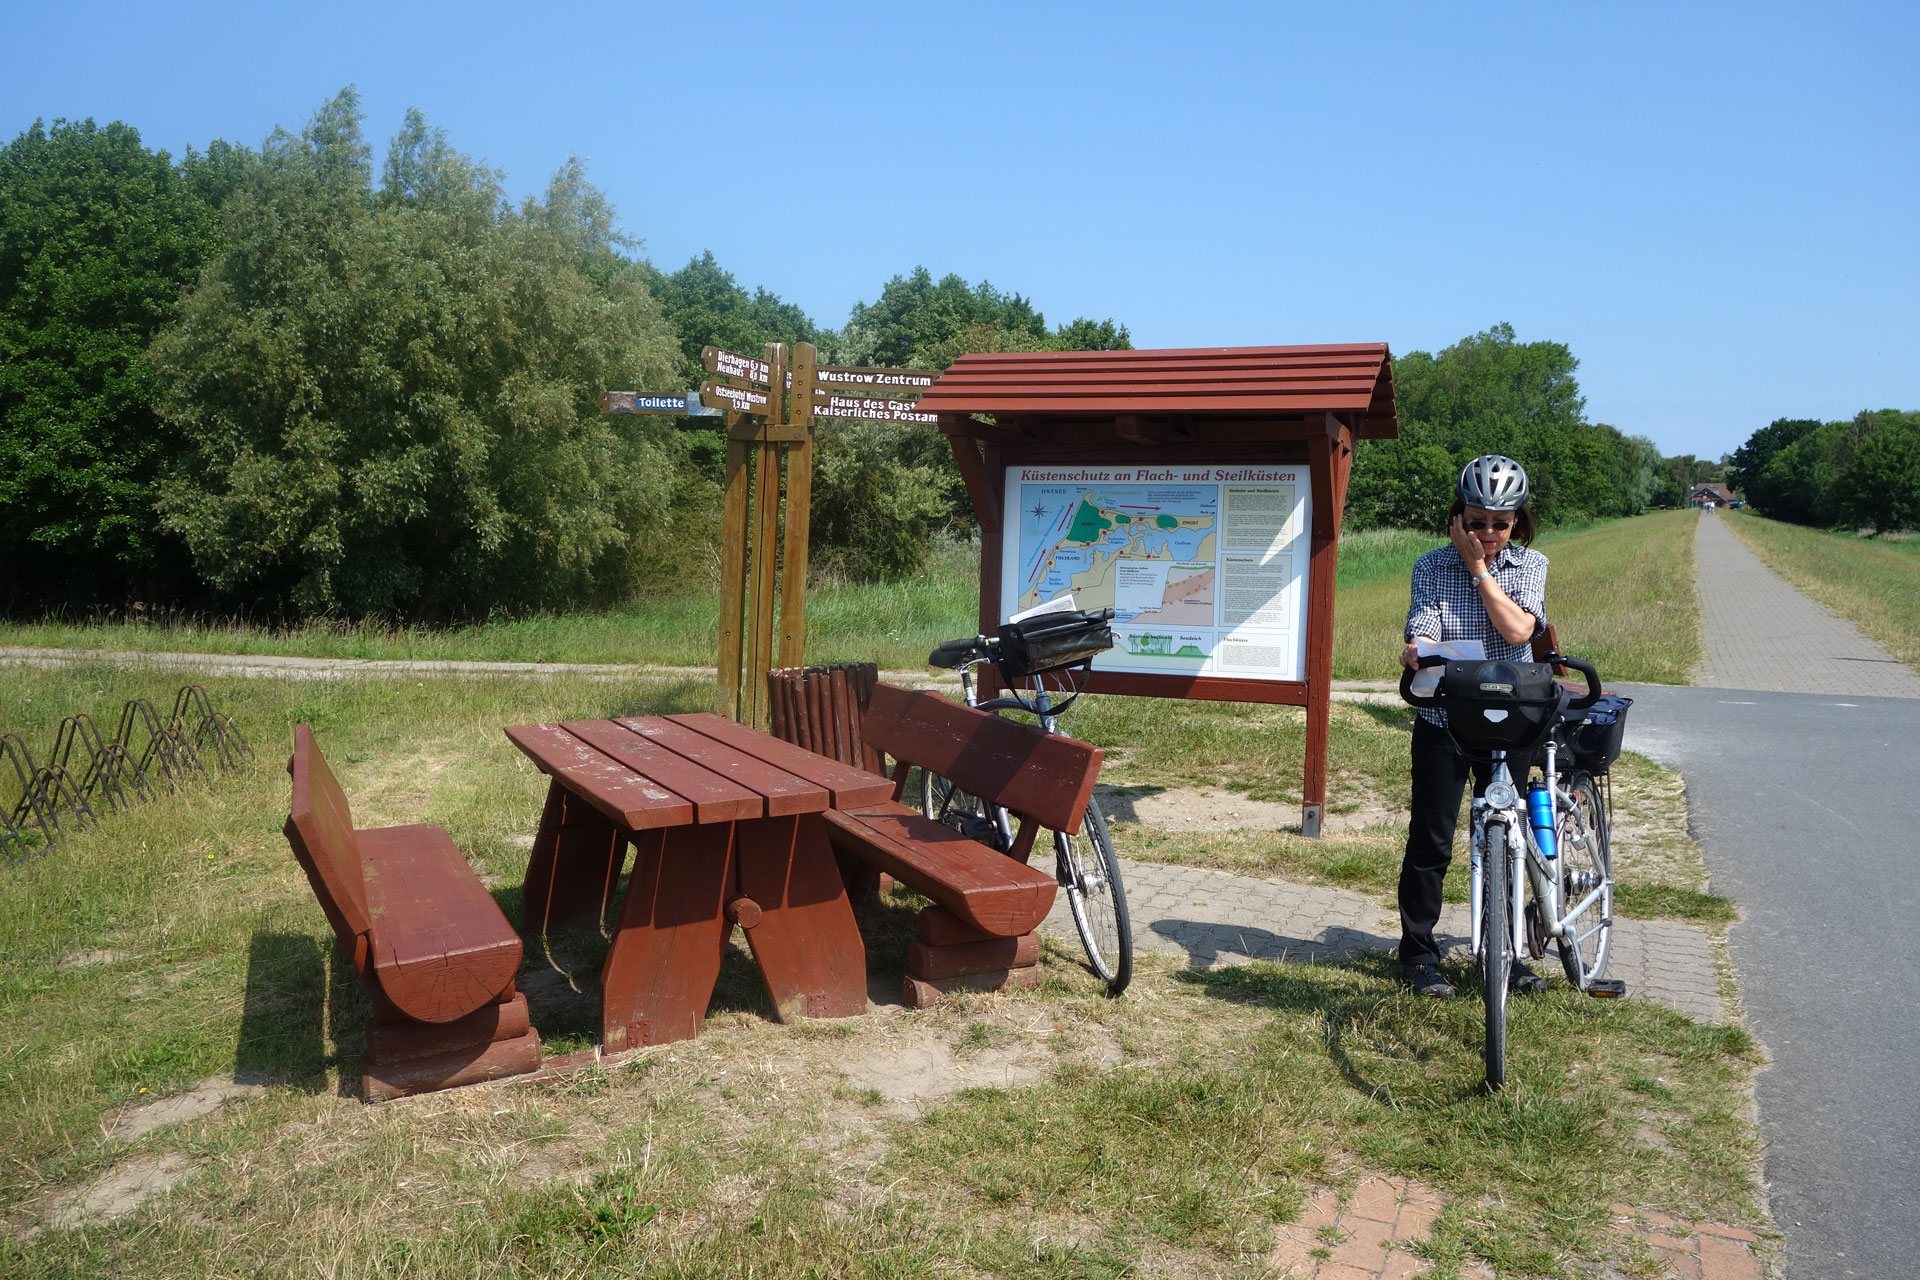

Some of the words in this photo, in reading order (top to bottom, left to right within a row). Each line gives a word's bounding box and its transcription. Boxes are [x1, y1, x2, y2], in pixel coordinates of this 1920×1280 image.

[717, 350, 750, 369] Dierhagen
[760, 362, 769, 373] km
[716, 361, 744, 378] Neuhaus
[759, 372, 768, 383] km
[818, 371, 874, 384] Wustrow
[876, 373, 931, 386] Zentrum
[639, 397, 684, 408] Toilette
[715, 385, 746, 400] Ostseehotel
[746, 392, 767, 405] Wustrow
[741, 401, 750, 410] km
[830, 397, 860, 408] Haus
[863, 399, 884, 410] des
[814, 405, 890, 420] Kaiserliches
[1021, 469, 1110, 481] Küstenschutz
[1114, 472, 1131, 481] an
[1136, 469, 1179, 481] Flach-
[1182, 469, 1211, 481] und
[1214, 469, 1296, 482] Steilküsten
